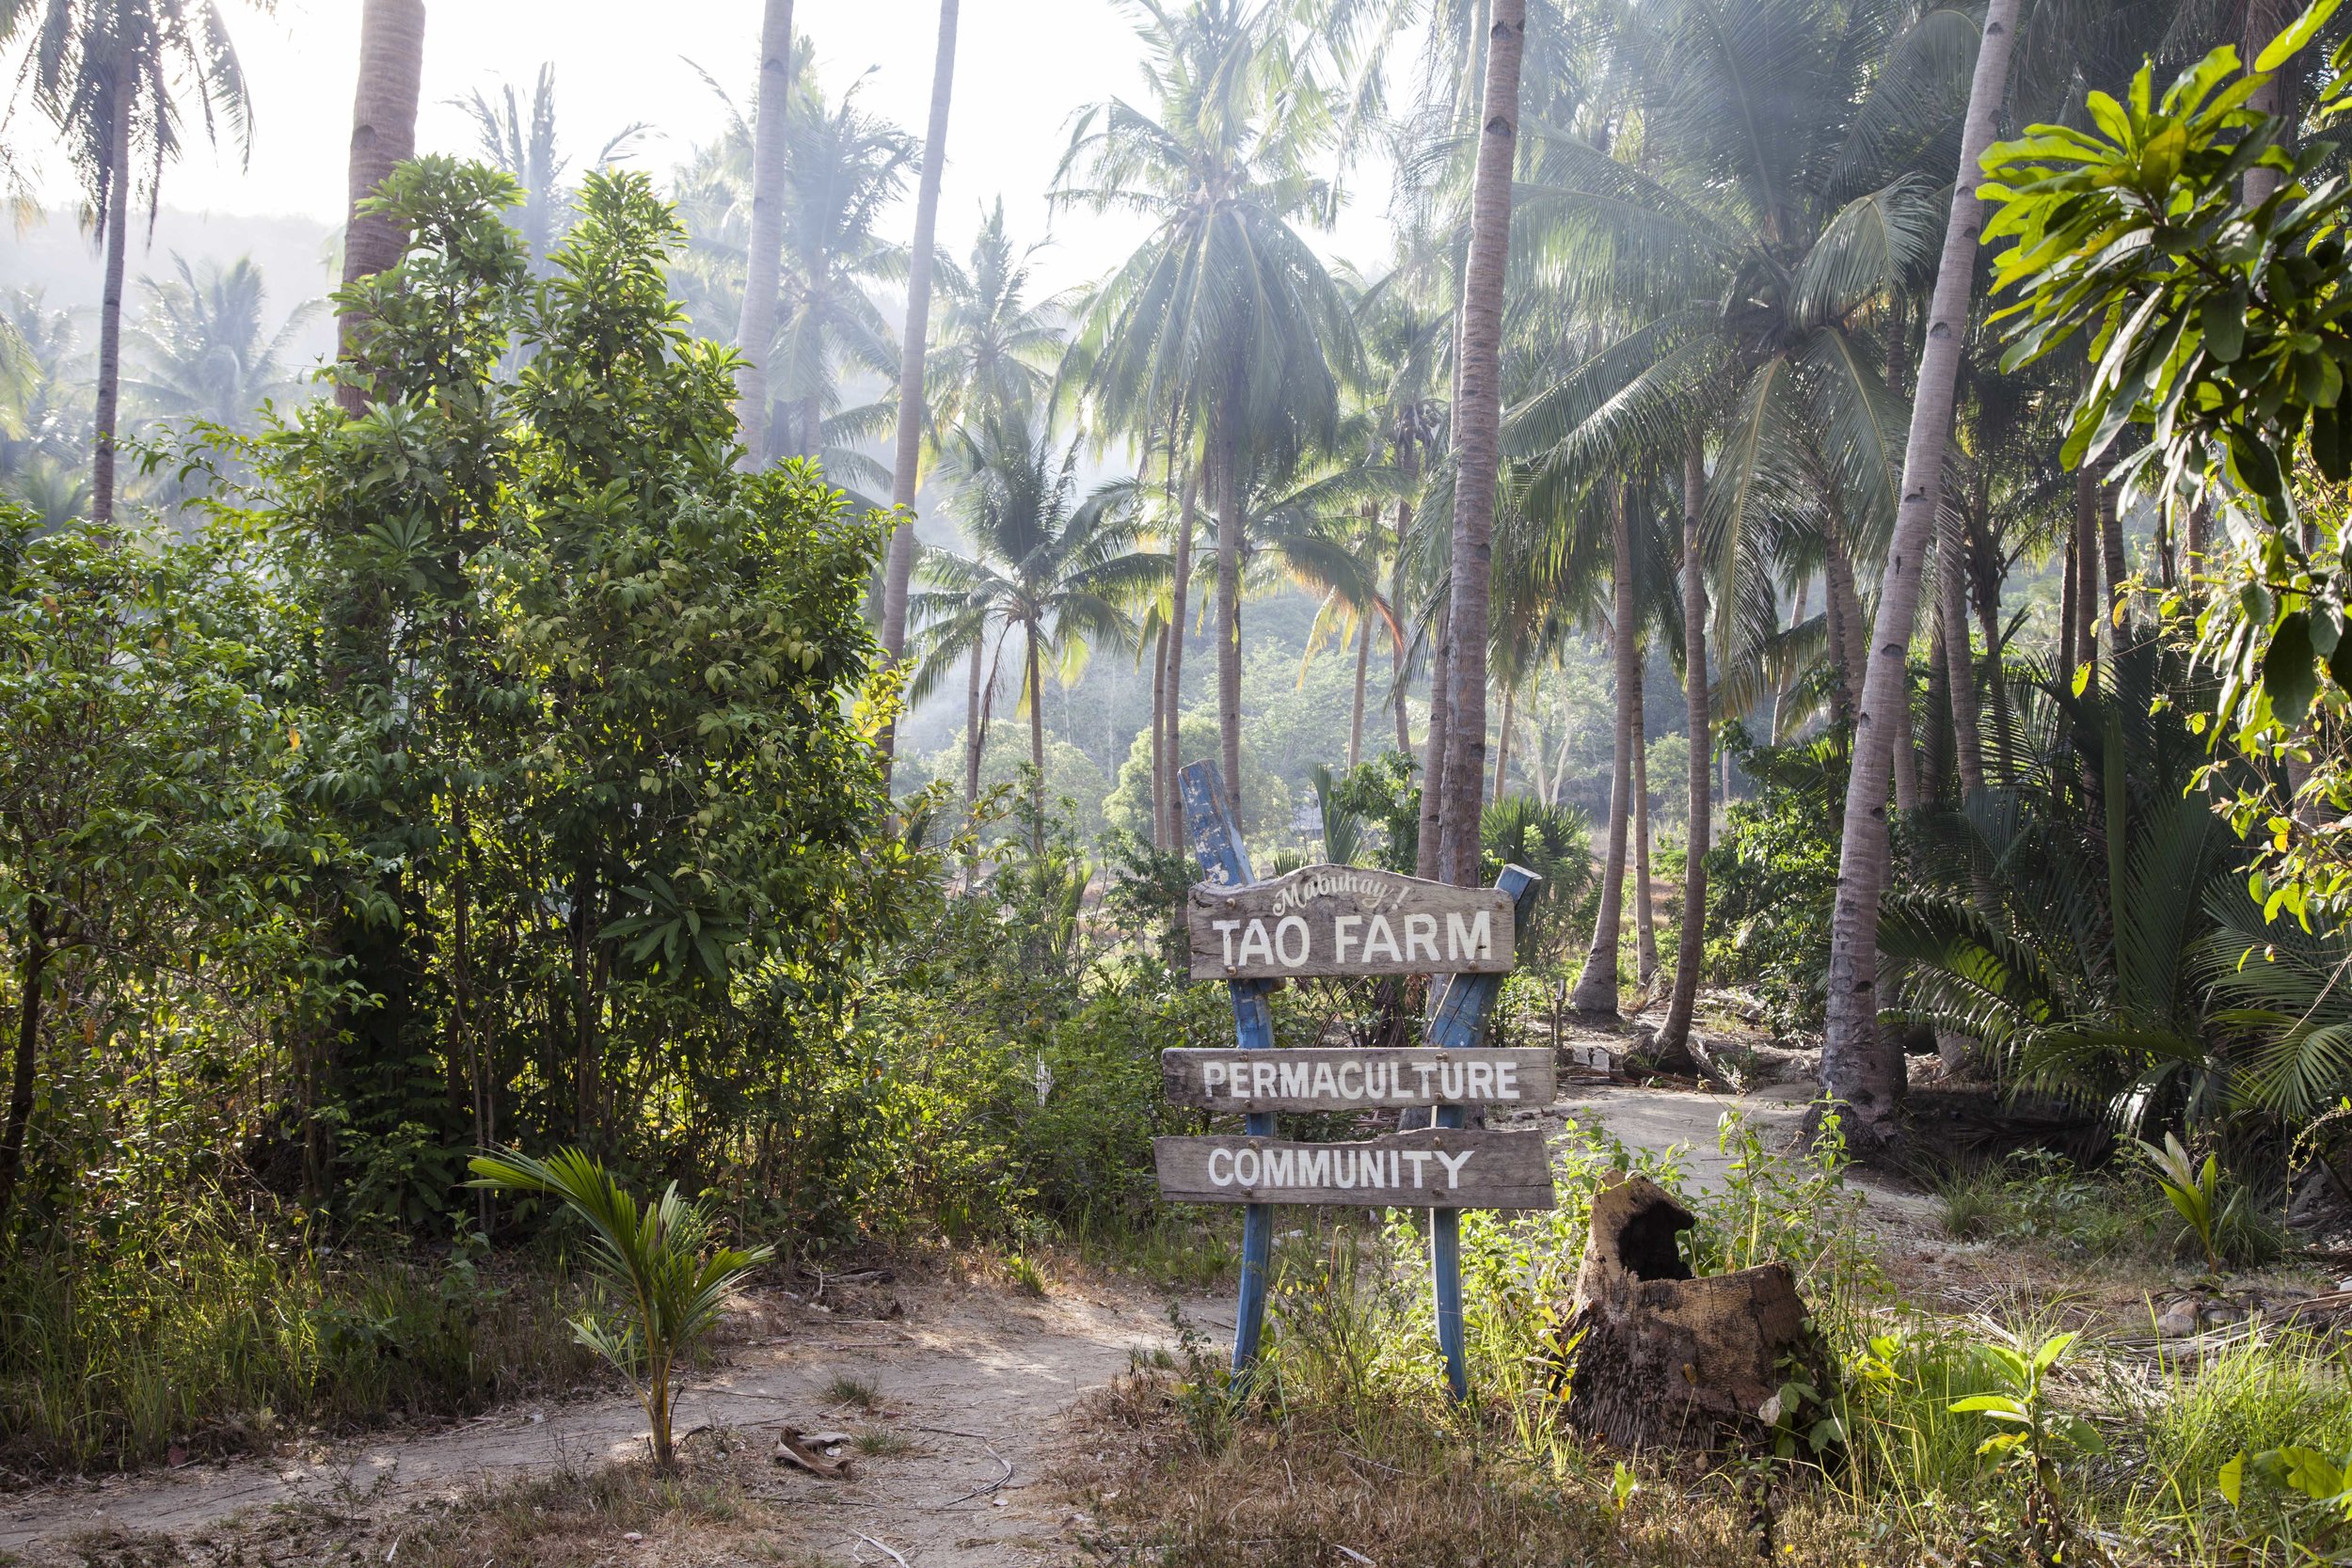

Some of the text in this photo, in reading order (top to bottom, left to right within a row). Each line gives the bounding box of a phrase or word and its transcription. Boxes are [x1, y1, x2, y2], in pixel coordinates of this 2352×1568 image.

[1213, 911, 1491, 968] TAO FARM
[1202, 1060, 1520, 1100] PERMACULTURE
[1208, 1148, 1475, 1189] COMMUNITY
